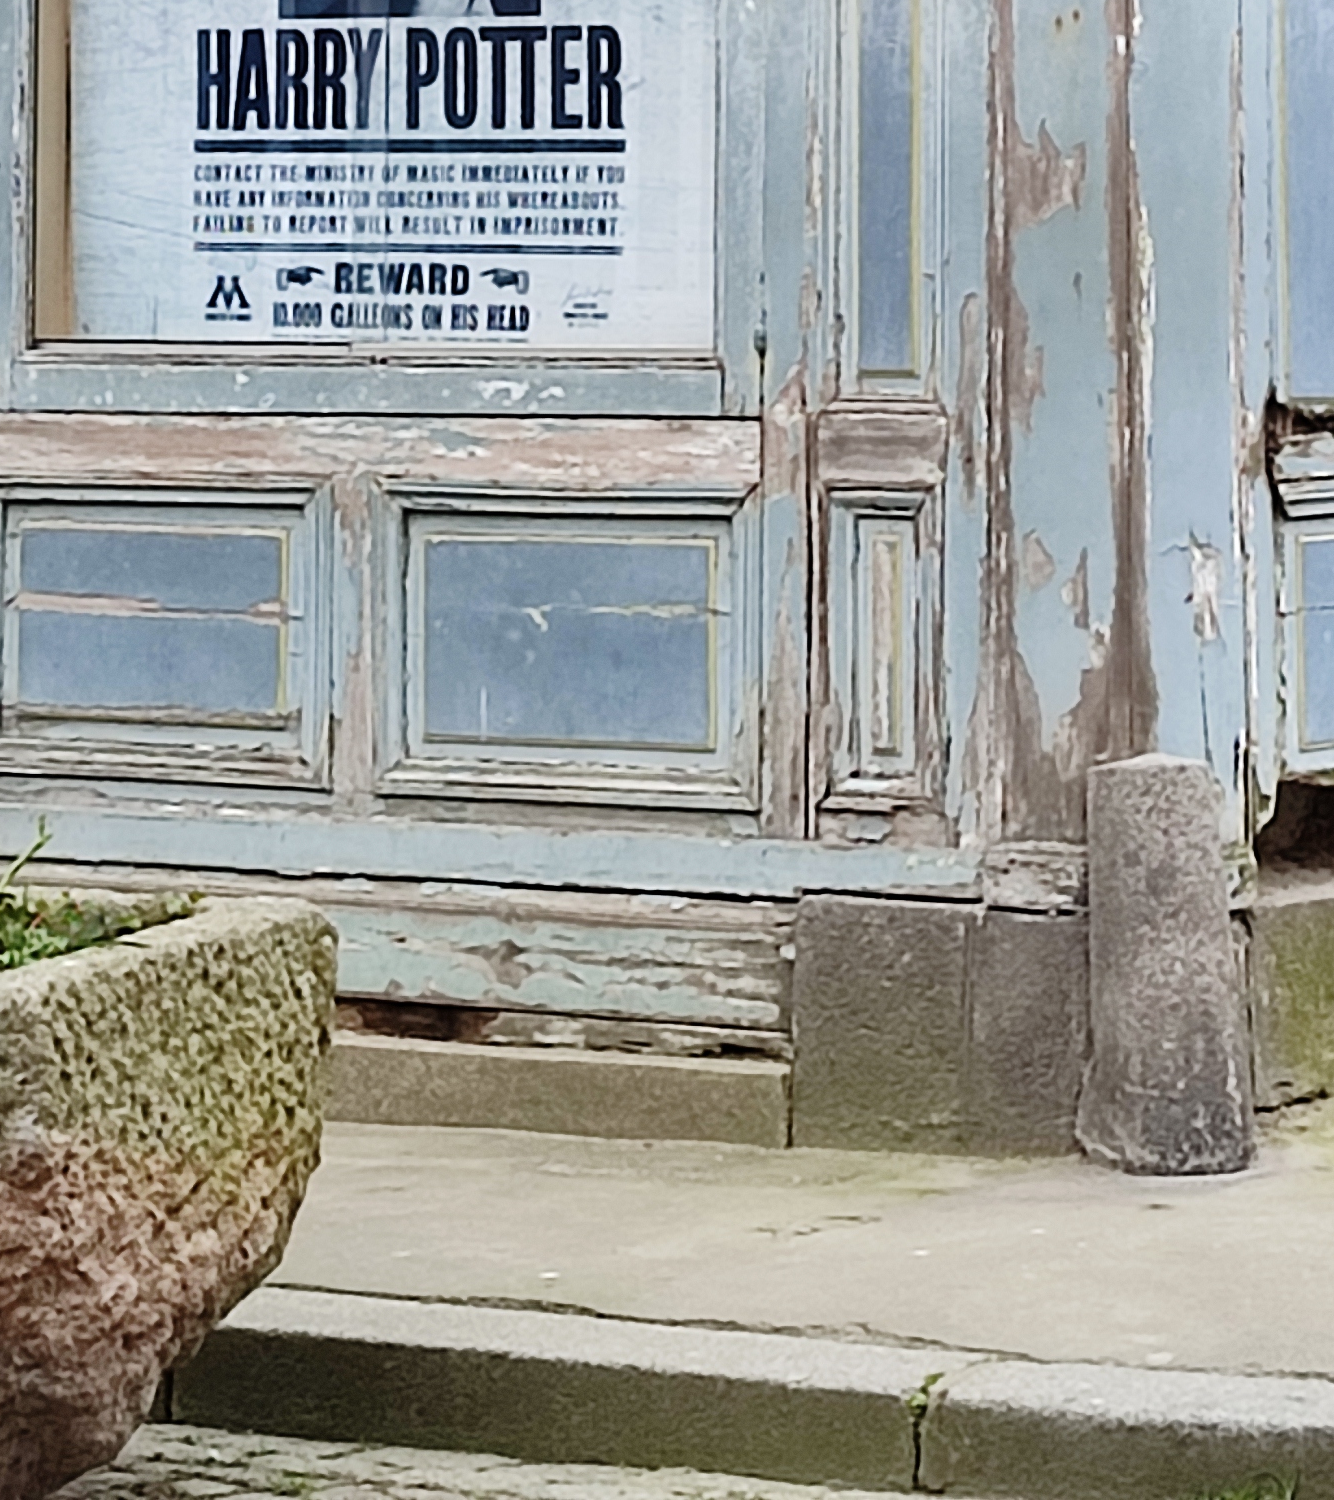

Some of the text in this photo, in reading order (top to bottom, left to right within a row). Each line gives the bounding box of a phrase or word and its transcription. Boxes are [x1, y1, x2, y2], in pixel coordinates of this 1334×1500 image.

[196, 25, 625, 131] HARRY POTTER
[194, 164, 263, 183] CONTACT
[270, 164, 297, 183] THE
[305, 164, 374, 183] MINISTRY
[381, 164, 400, 183] OF
[406, 164, 455, 183] MAGIC
[461, 164, 570, 183] IMMEDIATELY
[193, 215, 255, 235] FAILING
[262, 215, 282, 235] TO
[289, 215, 347, 235] REPORT
[353, 215, 393, 235] WILL
[402, 215, 463, 235] RESULT
[470, 215, 487, 235] IN
[334, 262, 470, 295] REWARD
